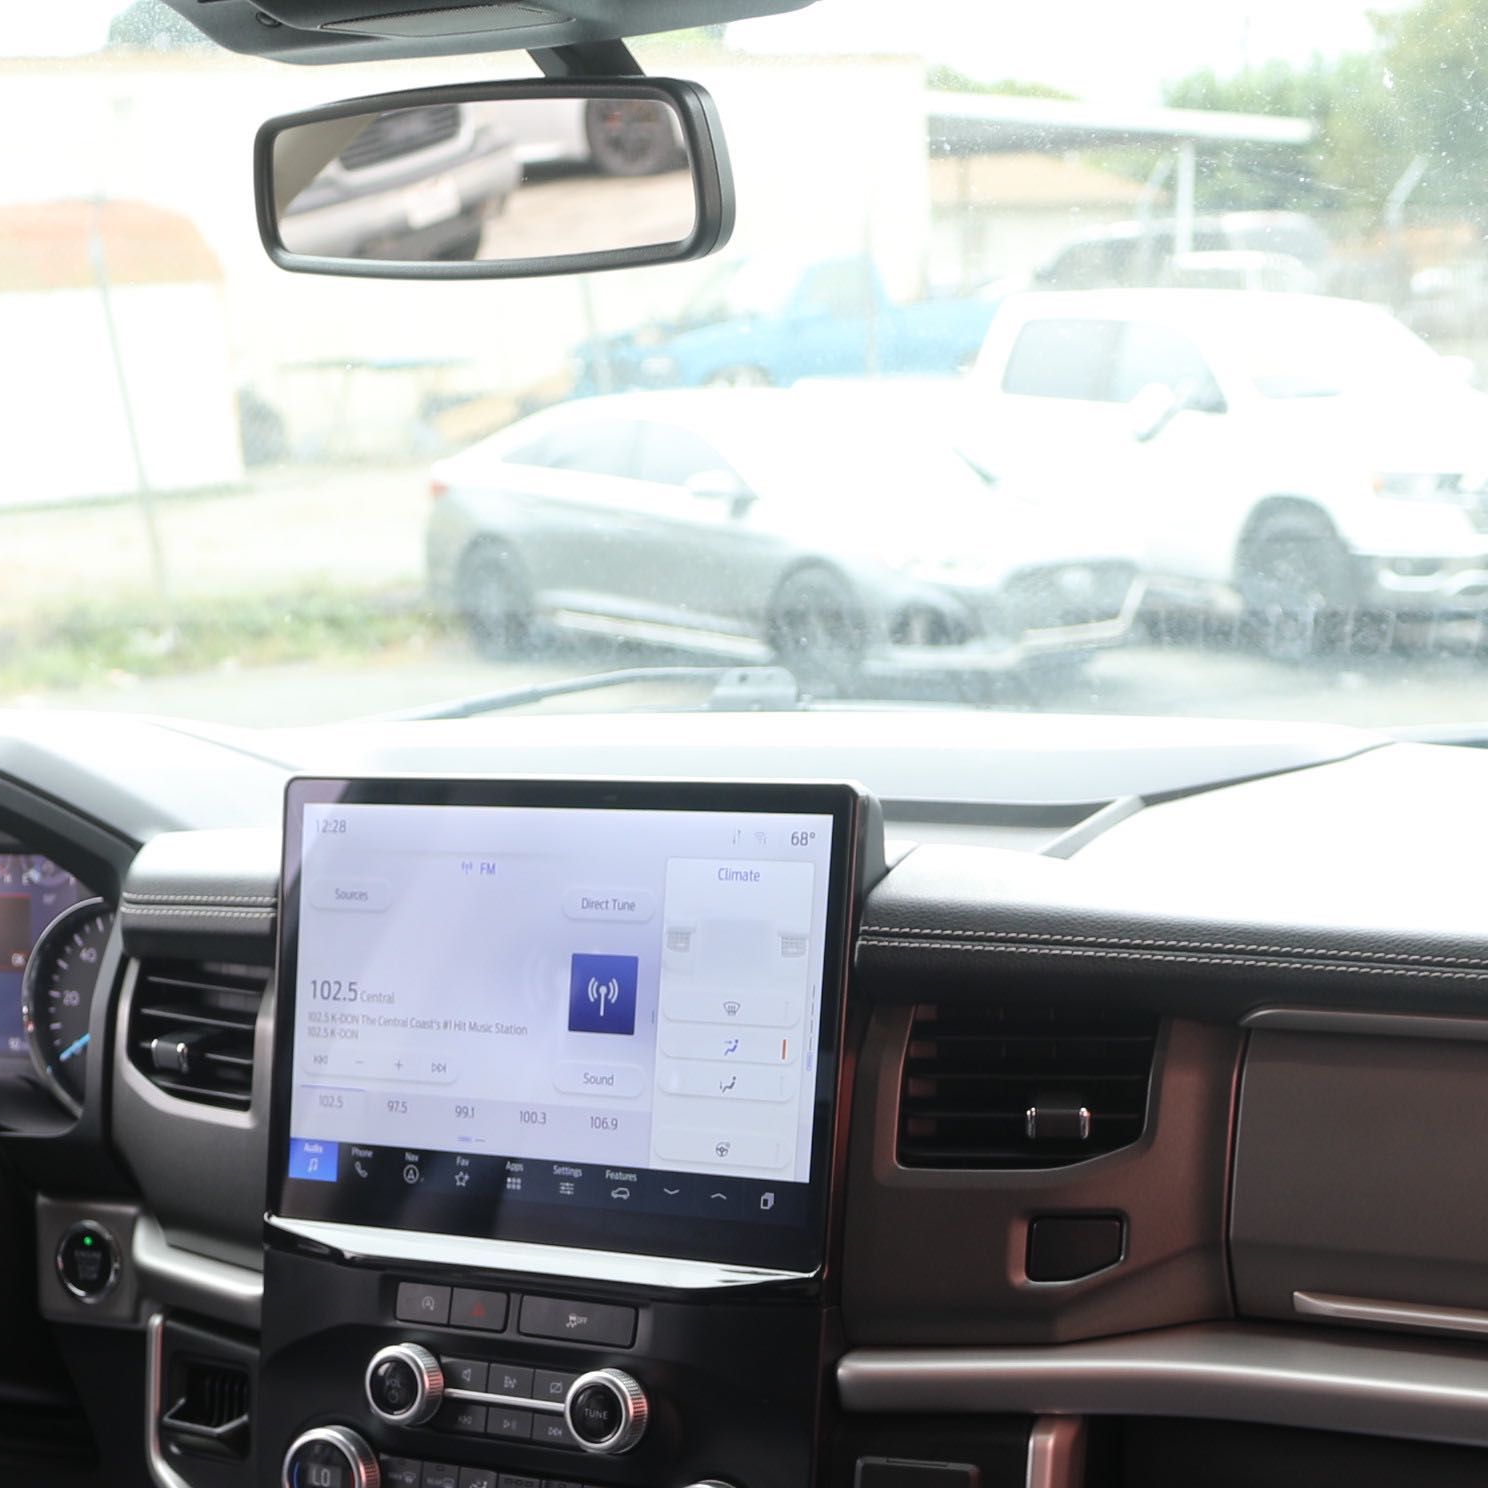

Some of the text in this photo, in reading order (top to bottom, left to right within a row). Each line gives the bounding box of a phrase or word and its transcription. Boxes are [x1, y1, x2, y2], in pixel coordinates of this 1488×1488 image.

[315, 819, 347, 834] 12:28
[791, 830, 816, 847] 68°
[480, 862, 496, 876] FM
[717, 867, 761, 883] Climate
[334, 888, 369, 902] Sources
[580, 896, 636, 912] Direct Tune
[63, 990, 81, 1007] 20
[310, 979, 396, 1005] 102.5 Central
[307, 1011, 529, 1037] 102.5 K-DON The Central Coast's #1 Hit Music Station
[307, 1025, 360, 1040] 102.5 K-DON
[583, 1072, 615, 1087] Sound
[318, 1094, 344, 1109] 102.5
[387, 1100, 408, 1114] 97.5
[454, 1105, 476, 1119] 99.1
[519, 1110, 547, 1125] 100.3
[590, 1115, 619, 1131] 106.9
[303, 1142, 324, 1154] Audio
[351, 1146, 374, 1159] Phone
[404, 1151, 419, 1163] Nav
[456, 1156, 470, 1167] Fav
[505, 1161, 525, 1174] Apps
[553, 1164, 583, 1179] Settings
[605, 1169, 638, 1183] Features
[583, 1408, 610, 1421] TUNE
